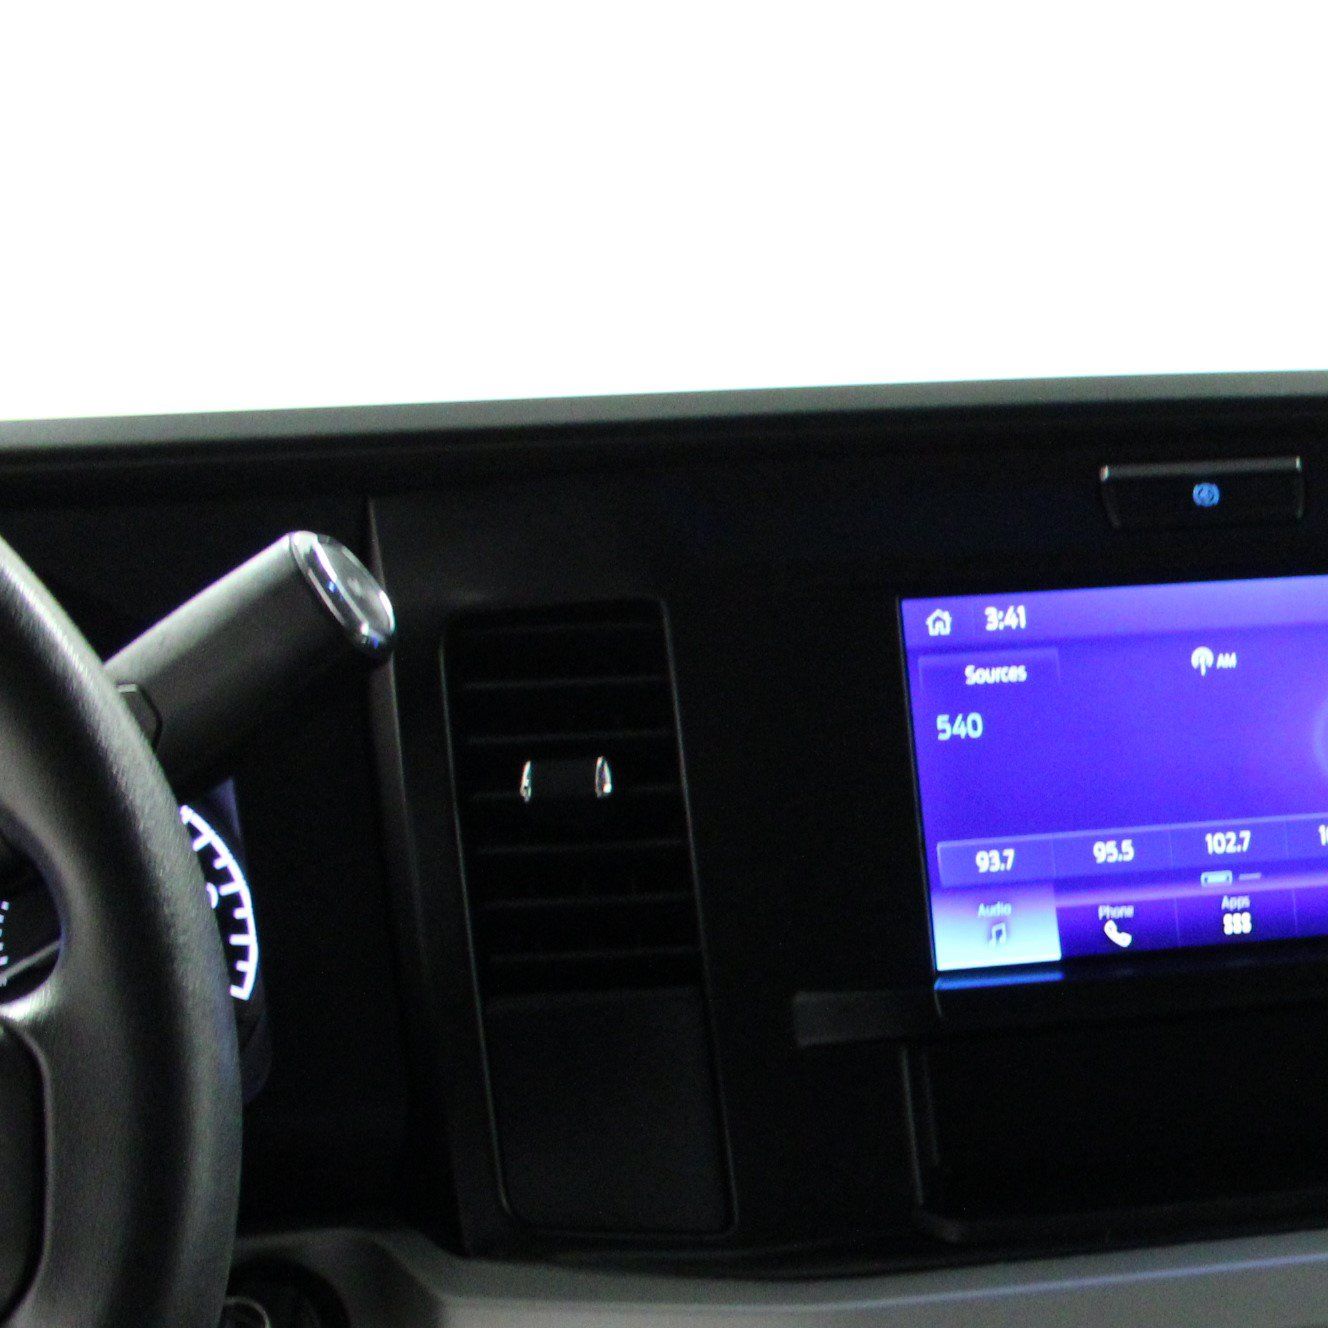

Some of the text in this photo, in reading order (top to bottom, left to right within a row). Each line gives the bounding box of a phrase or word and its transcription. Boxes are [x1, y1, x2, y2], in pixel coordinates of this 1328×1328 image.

[985, 605, 1026, 630] 3:41
[1217, 652, 1236, 669] AM
[965, 664, 1027, 685] Sources
[937, 713, 983, 740] 540
[975, 849, 1016, 872] 93.7
[1093, 840, 1134, 863] 95.5
[1205, 831, 1251, 854] 102.7
[978, 901, 1012, 917] Audio
[1098, 902, 1134, 919] Phone
[1221, 894, 1250, 914] Apps
